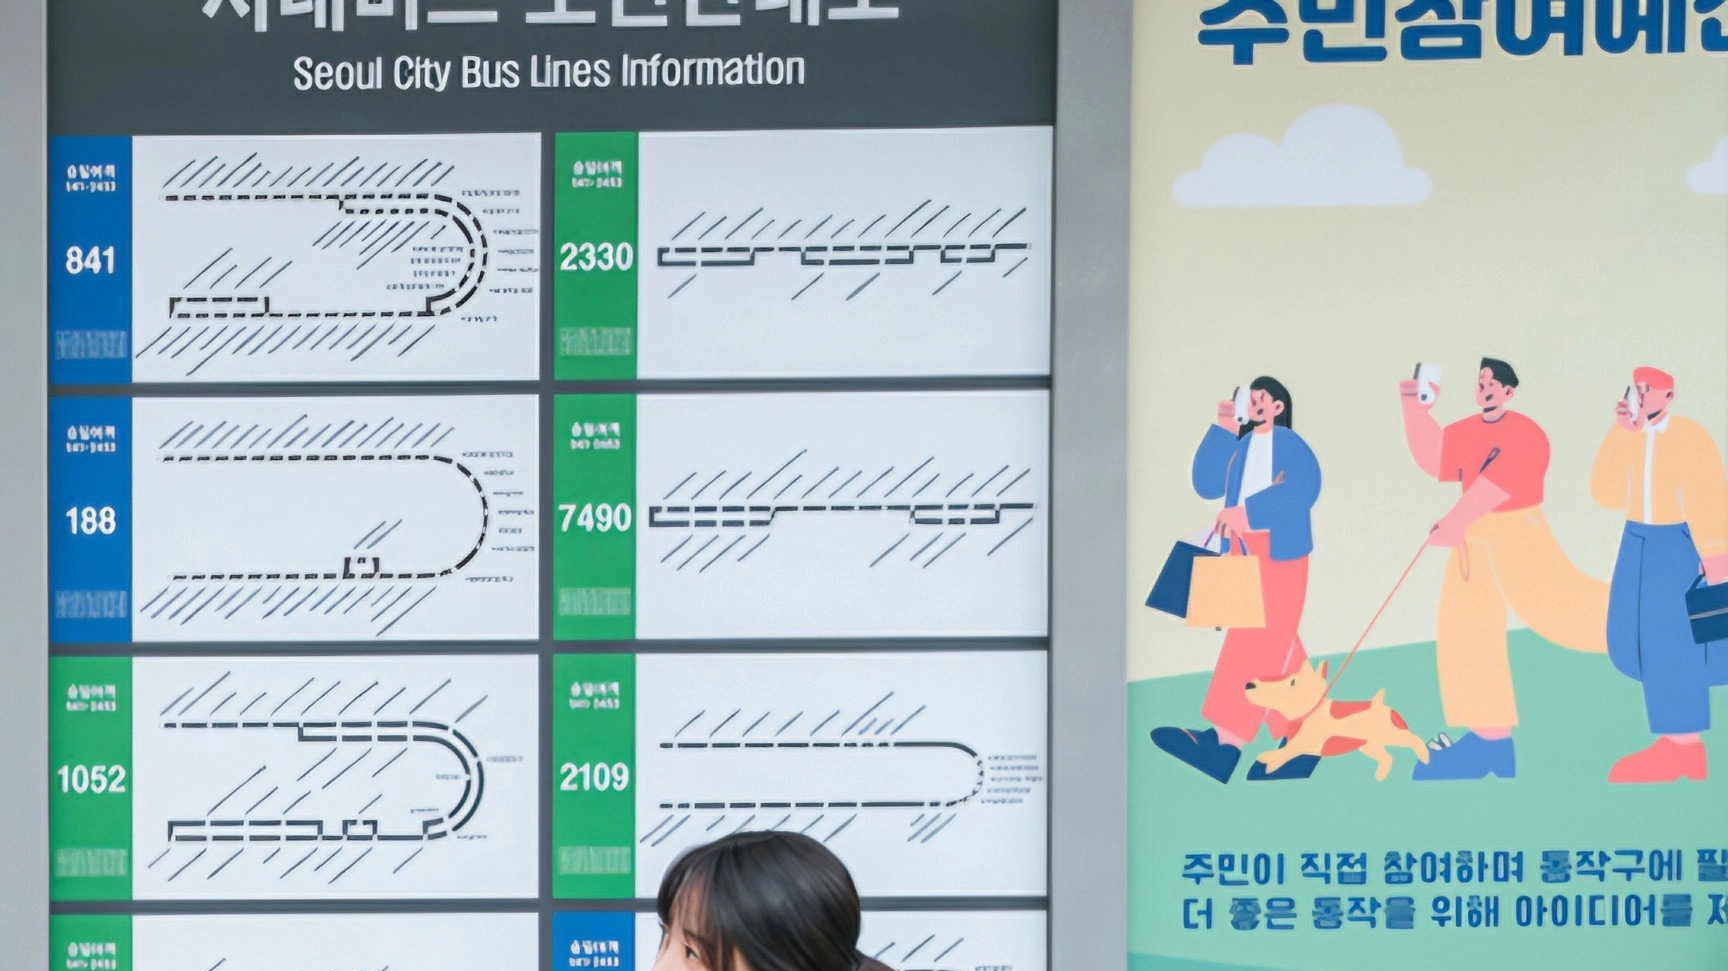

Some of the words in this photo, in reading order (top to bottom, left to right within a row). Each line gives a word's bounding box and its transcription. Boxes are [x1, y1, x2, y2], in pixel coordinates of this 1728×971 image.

[293, 55, 382, 91] Seoul
[394, 55, 450, 92] City
[462, 55, 520, 89] Bus
[530, 55, 611, 88] Lines
[622, 54, 805, 87] Information
[66, 245, 114, 274] 841
[560, 242, 634, 270] 2330
[66, 506, 116, 535] 188
[558, 503, 632, 532] 7490
[57, 764, 126, 794] 1052
[560, 762, 630, 791] 2109
[1182, 852, 1284, 886] 주민이
[1301, 852, 1367, 885] 직접
[1384, 850, 1523, 885] 참여하며
[1540, 849, 1682, 883] 동작구에
[1183, 897, 1213, 930] 더
[1431, 895, 1499, 928] 위해
[1516, 894, 1692, 928] 아이디어를
